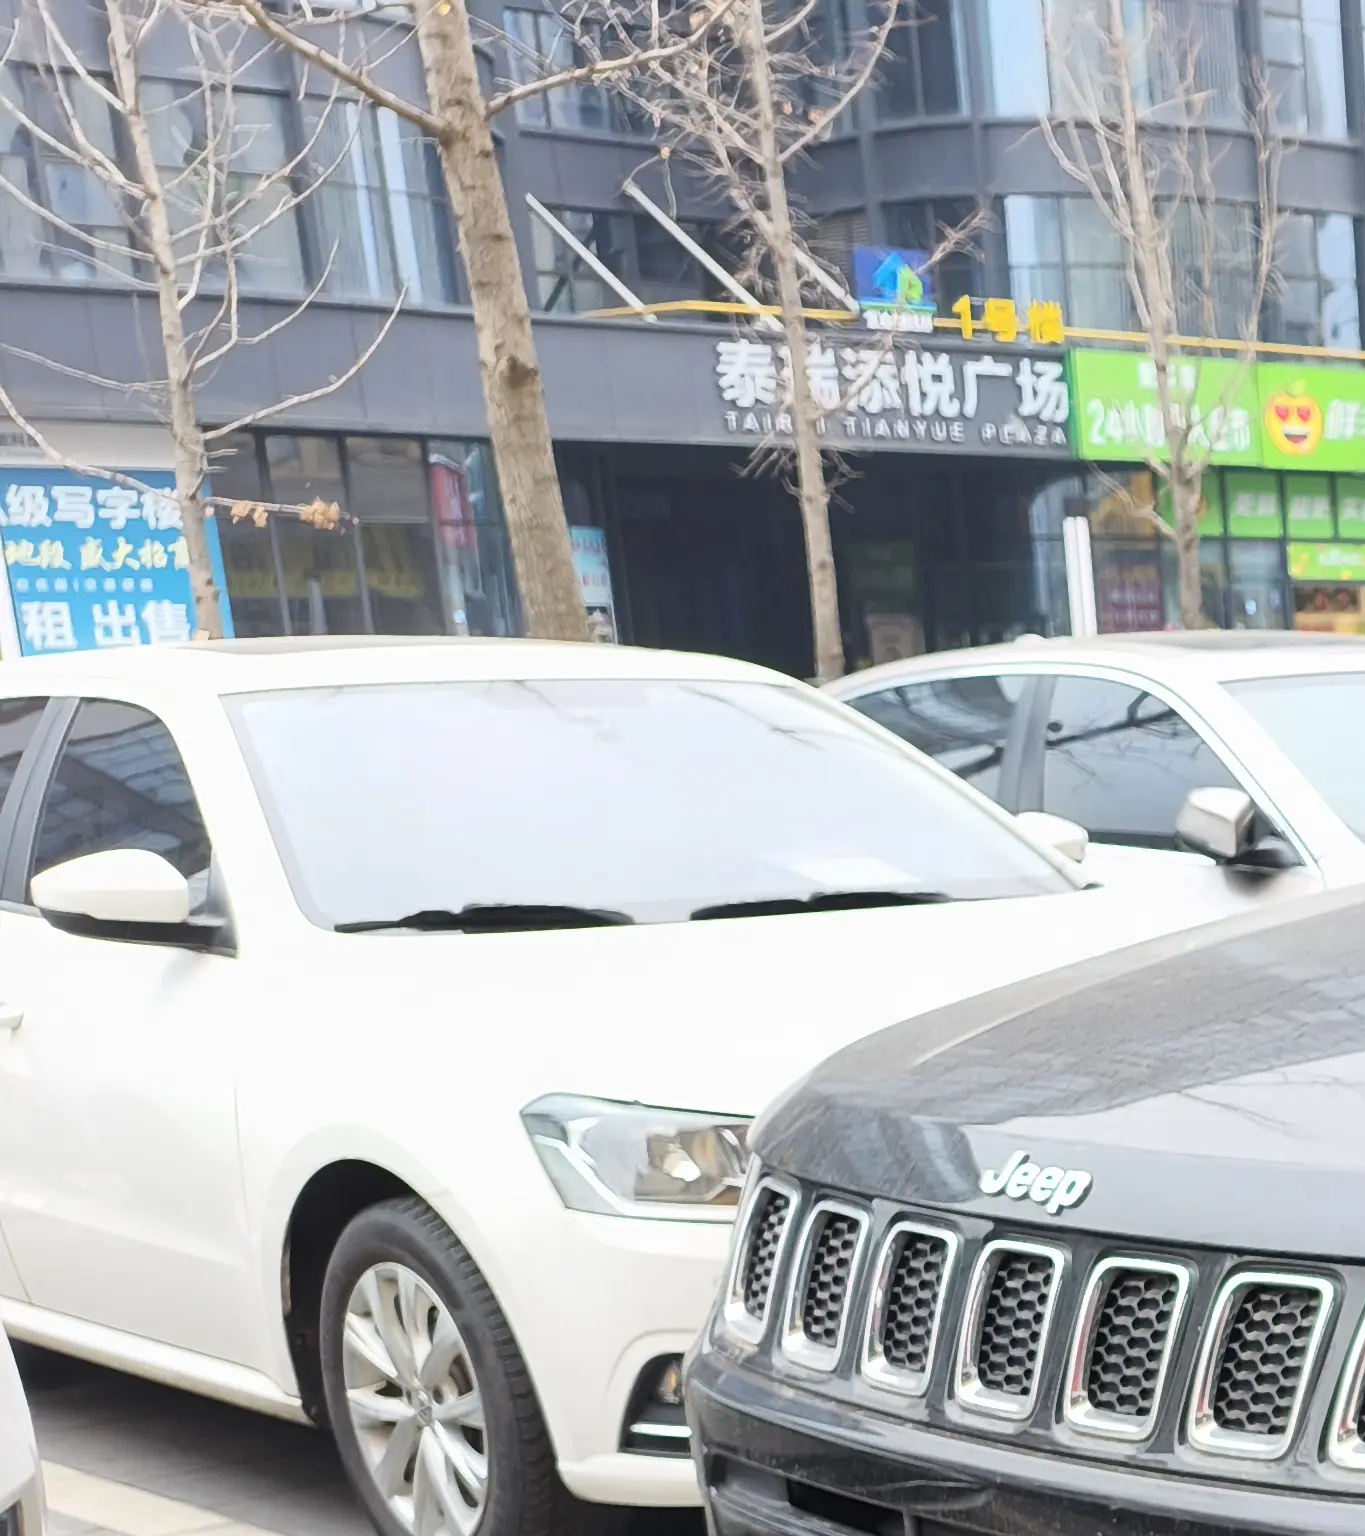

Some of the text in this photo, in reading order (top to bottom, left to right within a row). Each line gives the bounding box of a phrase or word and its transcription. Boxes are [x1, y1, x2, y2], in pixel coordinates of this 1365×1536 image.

[714, 338, 1070, 424] 泰瑞添悦广场
[723, 411, 829, 436] TAIRI
[842, 416, 966, 444] TIANYUE
[0, 483, 185, 530] 级写字楼
[20, 599, 192, 650] 租 出售
[979, 1149, 1094, 1217] Jeep
